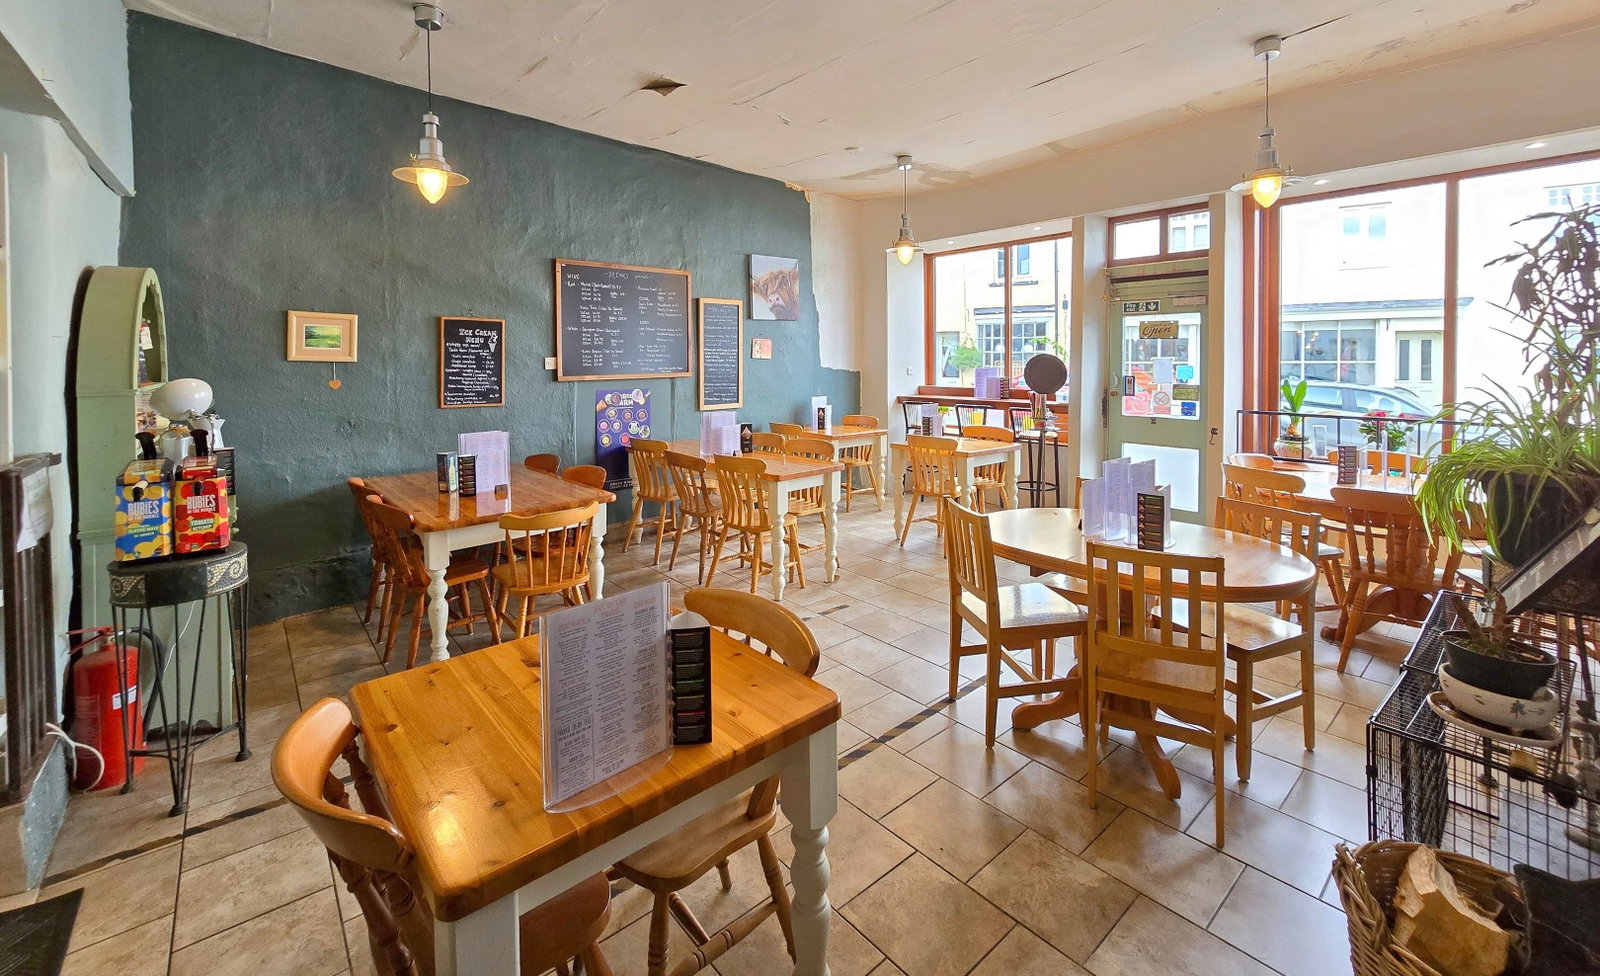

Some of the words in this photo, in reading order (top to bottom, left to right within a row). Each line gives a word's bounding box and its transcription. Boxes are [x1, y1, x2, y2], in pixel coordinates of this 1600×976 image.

[459, 328, 473, 336] ICE
[474, 328, 498, 337] CREAM
[1142, 323, 1171, 337] Open
[128, 501, 159, 516] RUBiES
[187, 495, 216, 511] RUBiES
[191, 518, 214, 526] TOMATO
